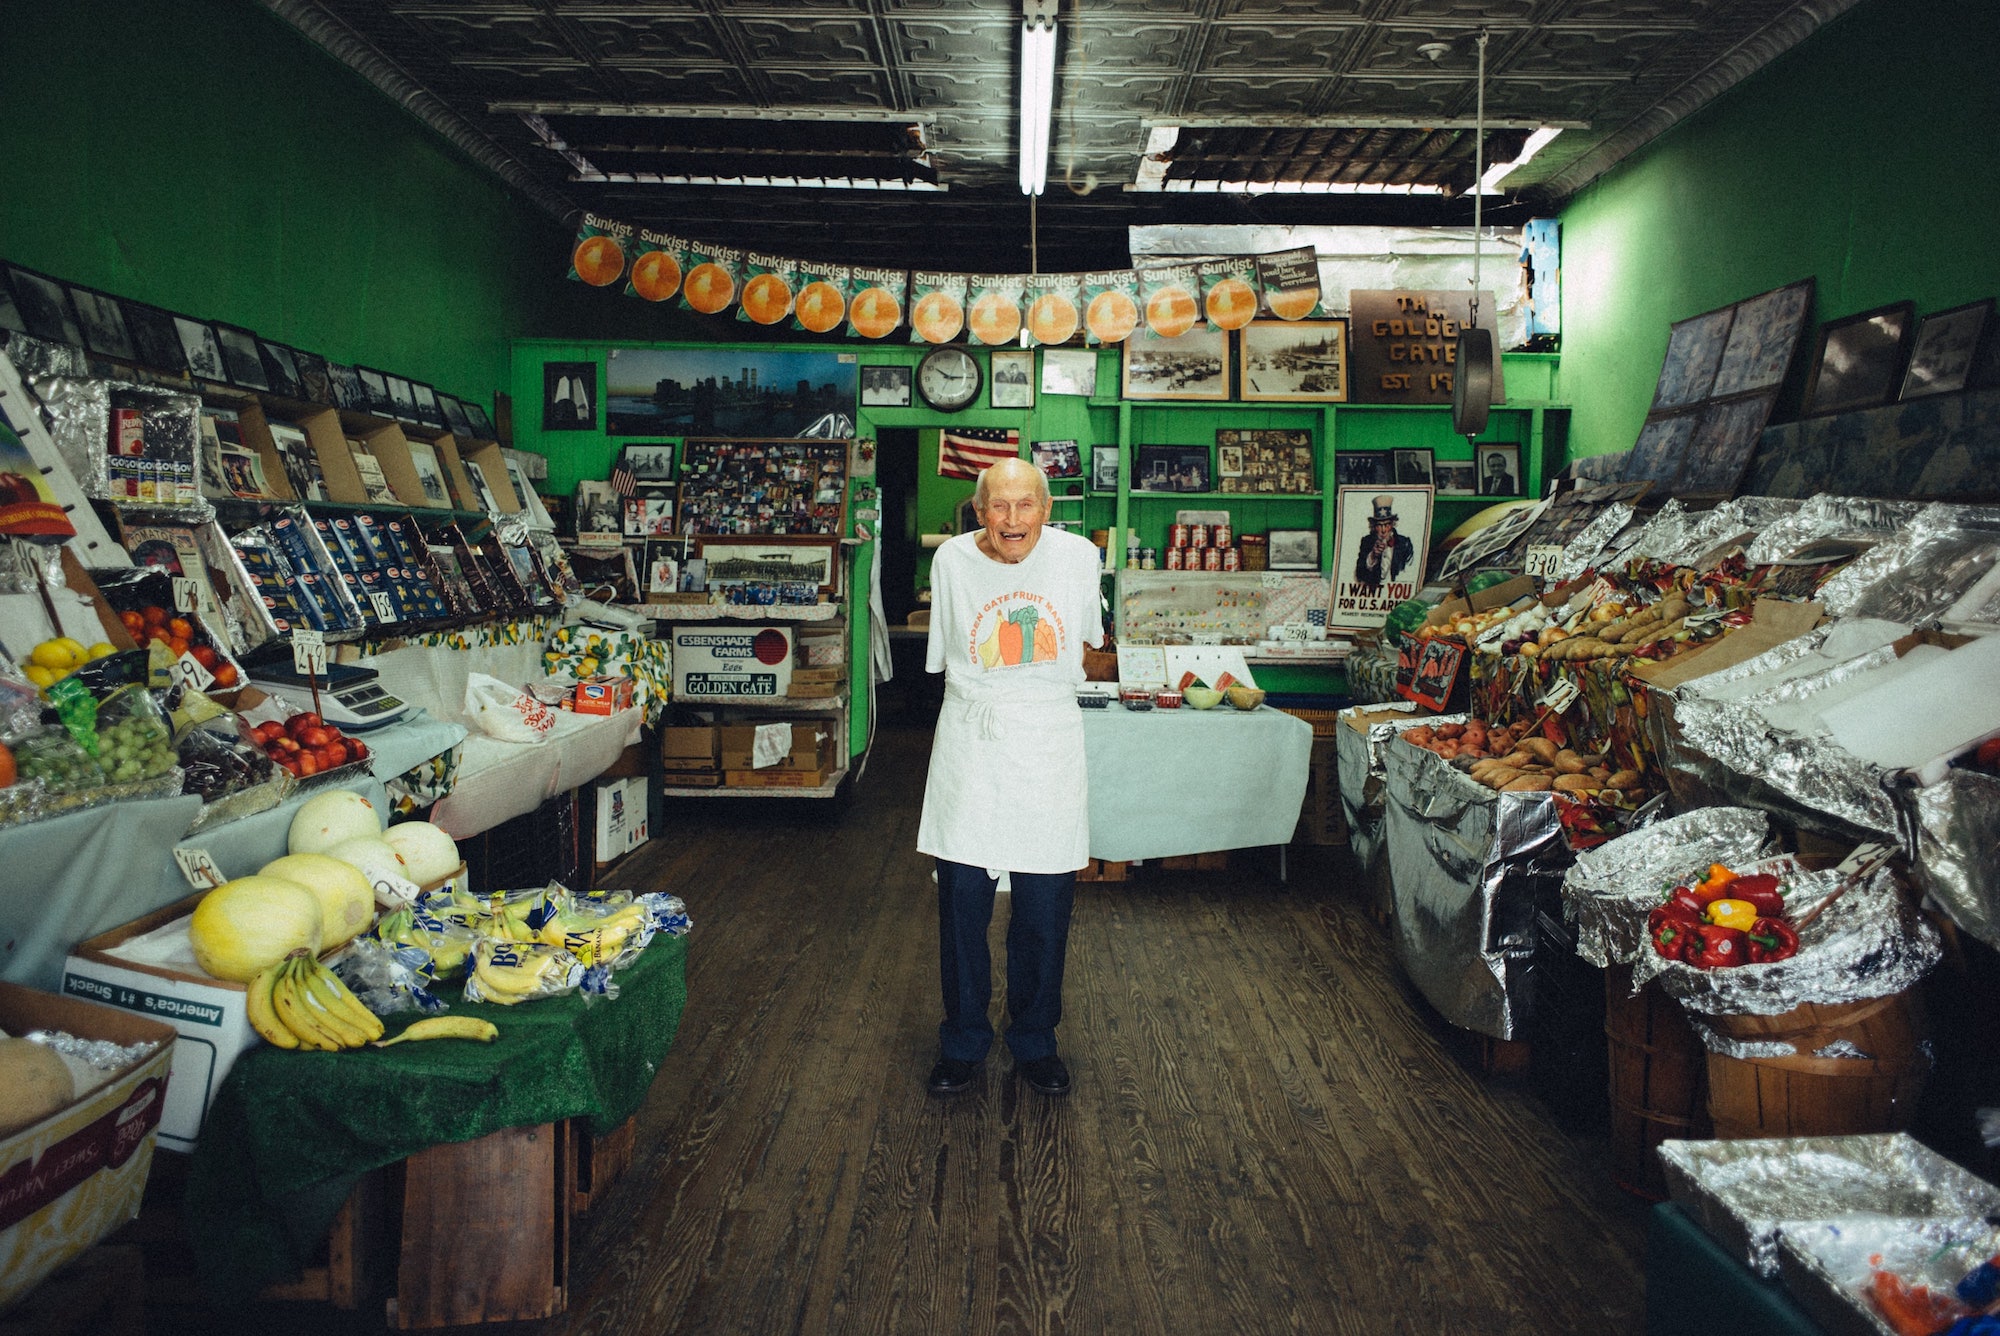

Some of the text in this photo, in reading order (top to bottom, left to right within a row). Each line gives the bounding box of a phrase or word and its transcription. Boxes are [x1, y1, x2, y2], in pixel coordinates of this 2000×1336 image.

[585, 213, 633, 237] Sunkist
[640, 229, 689, 251] Sunkist
[691, 241, 741, 261] Sunkist
[748, 252, 797, 272] Sunkist
[800, 260, 849, 279] Sunkist
[1201, 257, 1255, 277] Sunkist
[853, 267, 903, 284] Sunkist
[915, 271, 966, 288] Sunkist
[971, 273, 1024, 289] Sunkist
[1027, 273, 1079, 289] Sunkist
[1085, 270, 1137, 287] Sunkist
[1143, 265, 1195, 283] Sunkist
[1390, 343, 1457, 363] GATE
[1381, 373, 1412, 390] EST
[1528, 553, 1557, 575] 398
[1341, 583, 1412, 600] I WANT YOU
[1338, 599, 1356, 610] FOR
[969, 612, 984, 665] GOLDEN
[983, 594, 1010, 612] GATE
[1013, 591, 1044, 604] FRUIT
[681, 636, 752, 646] ESBENSHADE
[715, 647, 753, 657] FARMS
[722, 663, 743, 672] Eggs
[688, 682, 773, 694] GOLDEN GATE
[69, 978, 220, 1021] America's #1 Snack
